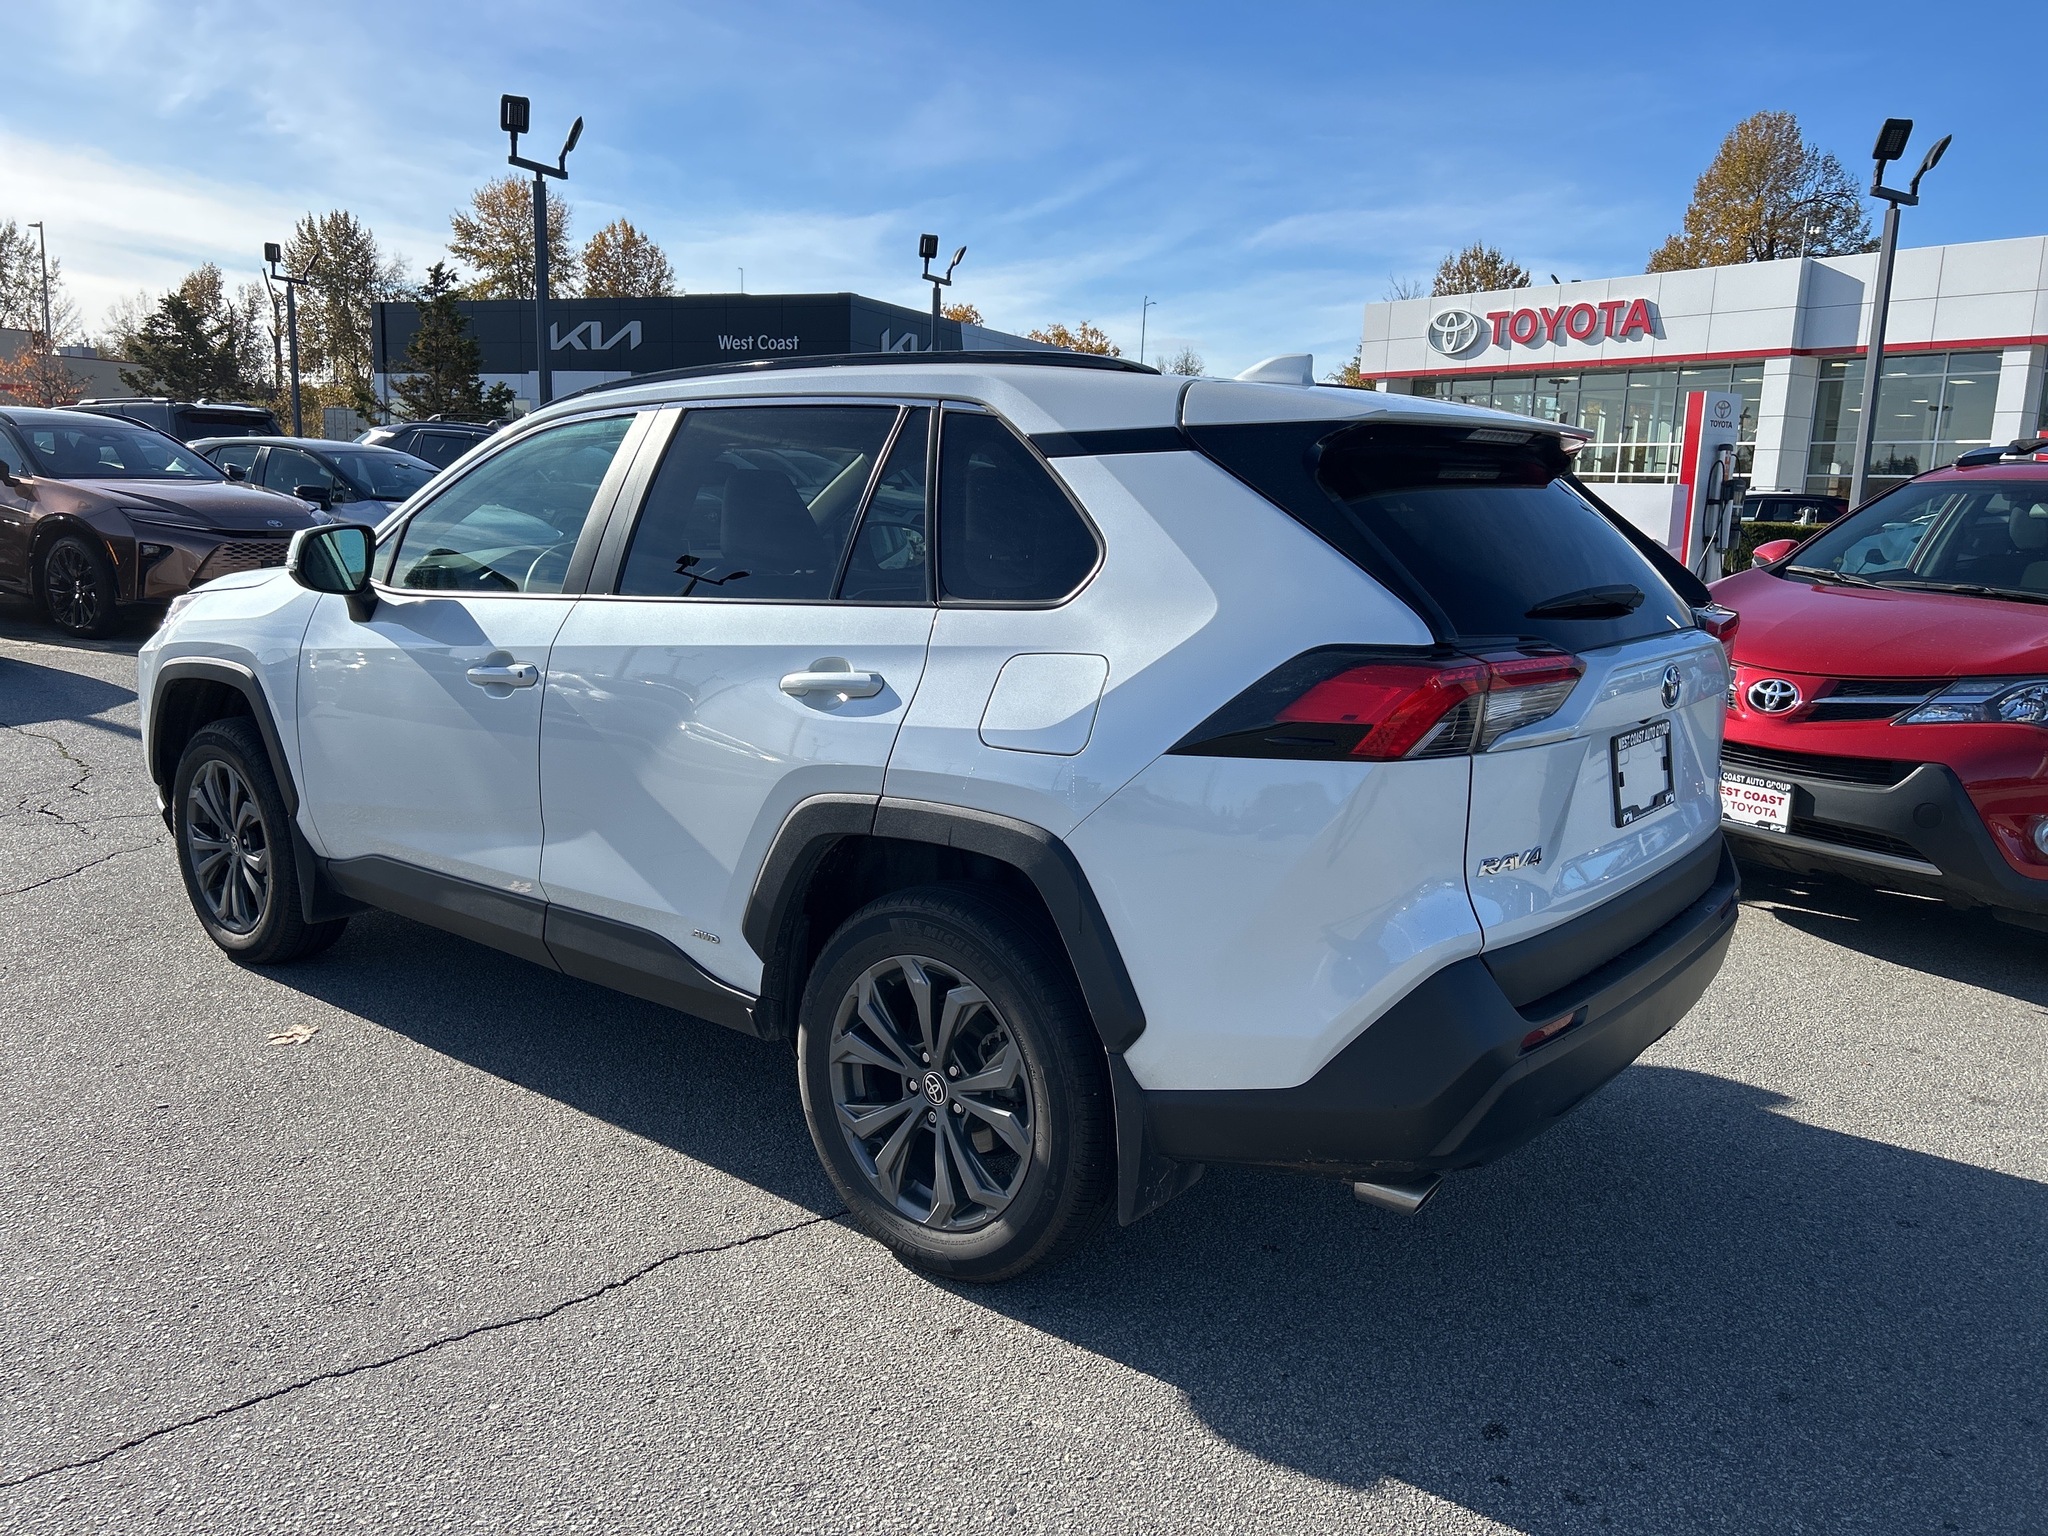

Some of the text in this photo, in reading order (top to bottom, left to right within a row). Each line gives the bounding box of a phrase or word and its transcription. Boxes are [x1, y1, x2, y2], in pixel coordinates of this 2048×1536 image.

[1486, 298, 1653, 345] TOYOTA
[549, 320, 642, 351] KIA
[718, 334, 799, 350] West Coast
[881, 328, 941, 352] KI
[1709, 419, 1733, 429] TOYOTA
[1630, 730, 1645, 747] COAST
[1645, 726, 1656, 740] AUTO
[1722, 772, 1745, 783] COAST
[1746, 776, 1765, 787] AUTO
[1719, 785, 1785, 806] EST COAST
[1730, 800, 1777, 818] TOYOTA
[1476, 846, 1542, 878] RAV4
[922, 925, 1001, 983] MICHELIN
